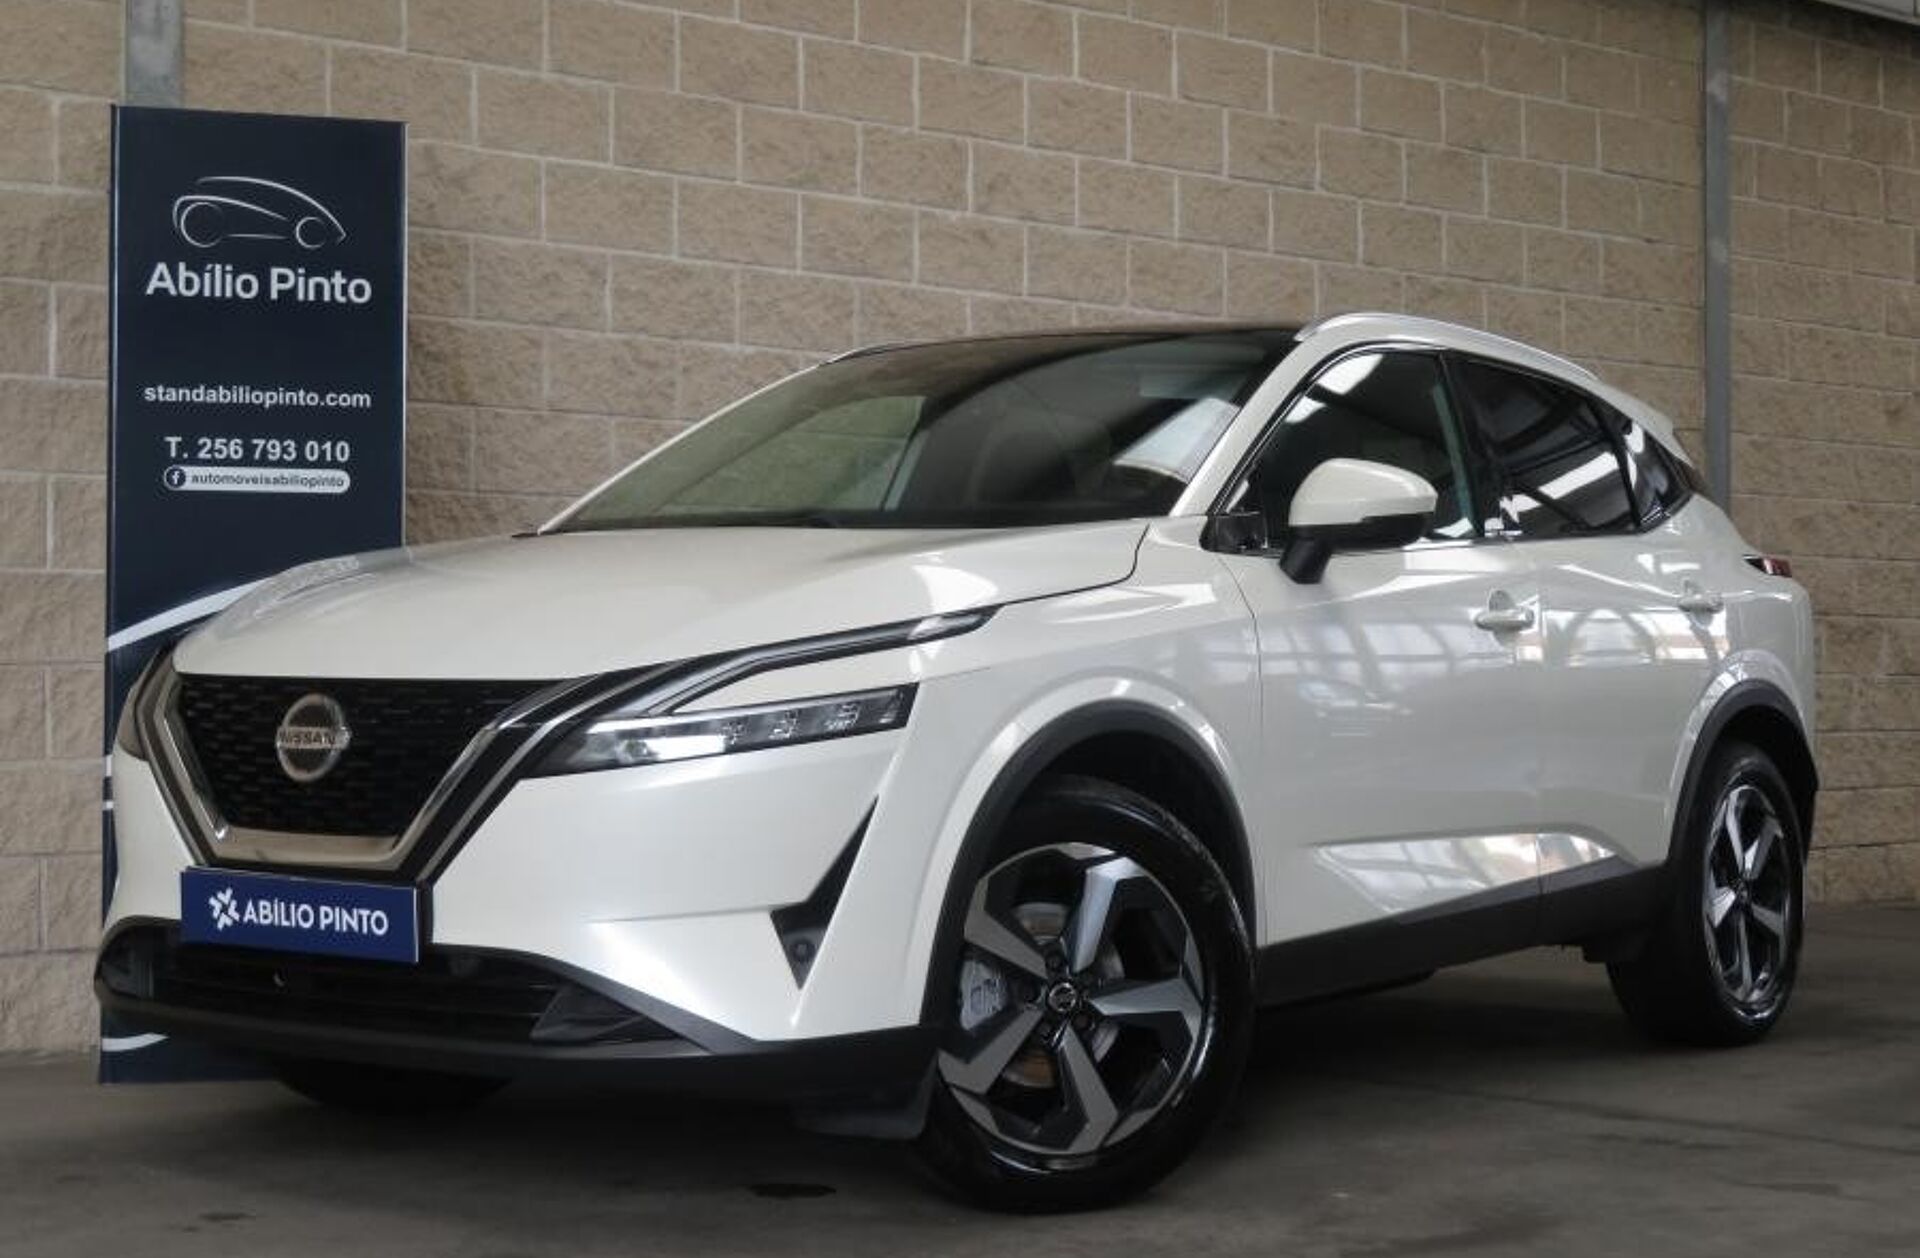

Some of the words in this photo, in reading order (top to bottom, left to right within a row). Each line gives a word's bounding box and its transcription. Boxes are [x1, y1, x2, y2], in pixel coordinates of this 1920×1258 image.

[145, 261, 259, 299] Abílio
[270, 266, 372, 303] Pinto
[144, 385, 372, 408] standabiliopinto.com
[164, 436, 188, 459] T.
[197, 437, 243, 460] 256
[251, 438, 297, 461] 793
[304, 440, 350, 463] 010
[278, 729, 338, 746] NISSAN
[319, 906, 389, 936] PINTO
